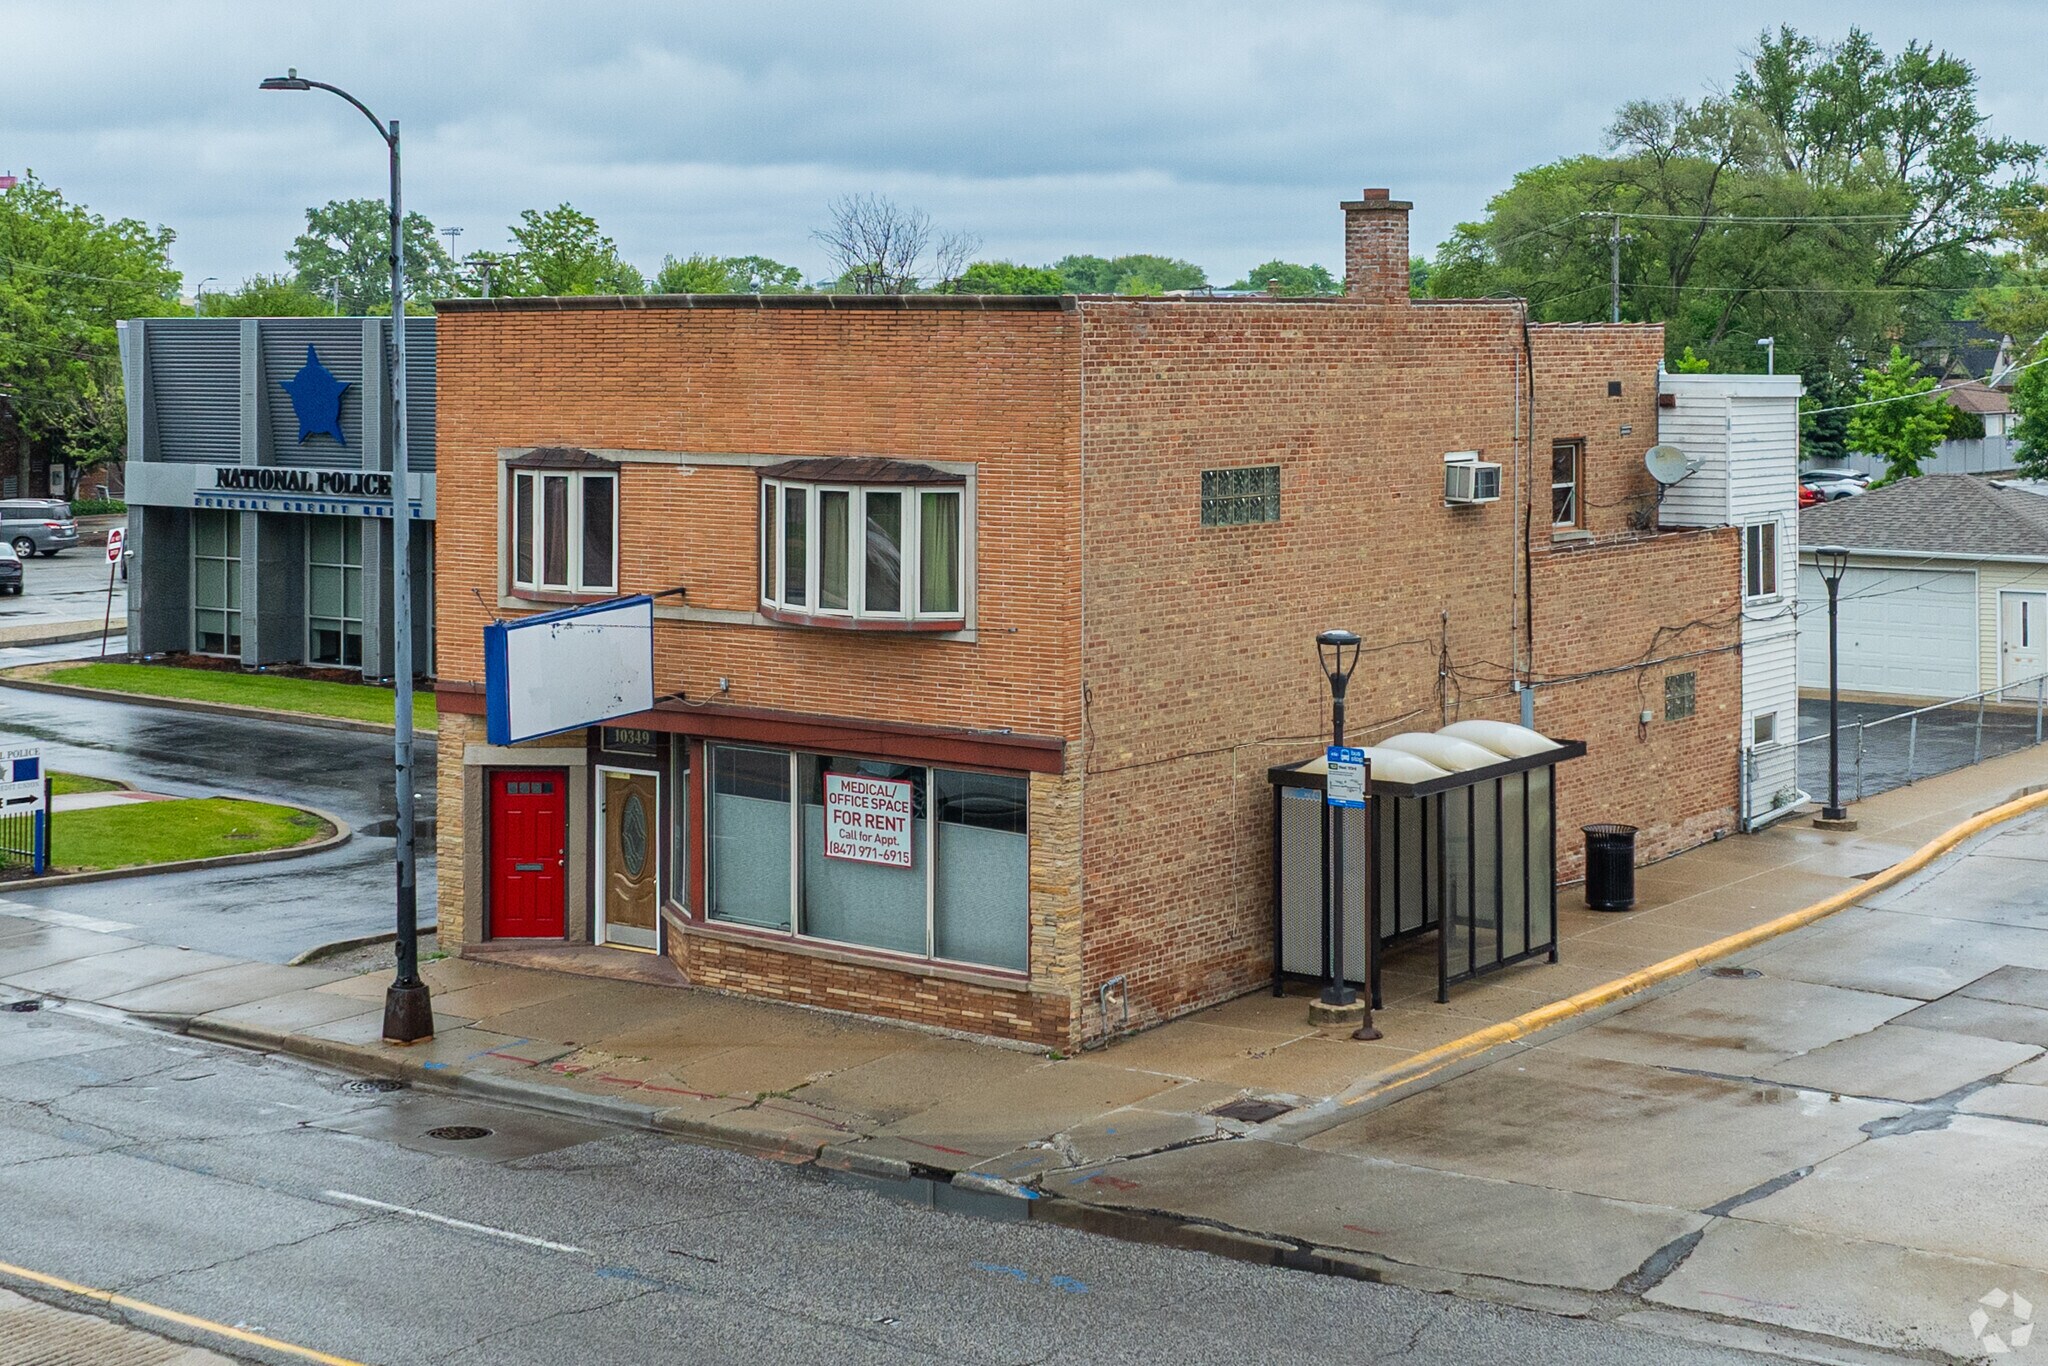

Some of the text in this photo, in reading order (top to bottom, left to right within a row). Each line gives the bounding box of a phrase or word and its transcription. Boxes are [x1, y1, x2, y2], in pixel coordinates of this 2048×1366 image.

[216, 468, 392, 495] NATIONAL POLICE
[195, 497, 421, 518] FEDERAL CREDIT UNIN
[615, 729, 650, 745] 10349
[7, 747, 40, 758] POLICE
[841, 780, 897, 799] MEDICAL/
[829, 793, 909, 813] OFFICE SPACE
[833, 809, 906, 832] FOR RENT
[839, 828, 899, 847] Call for Appt.
[829, 841, 910, 863] (847) 971-6915
